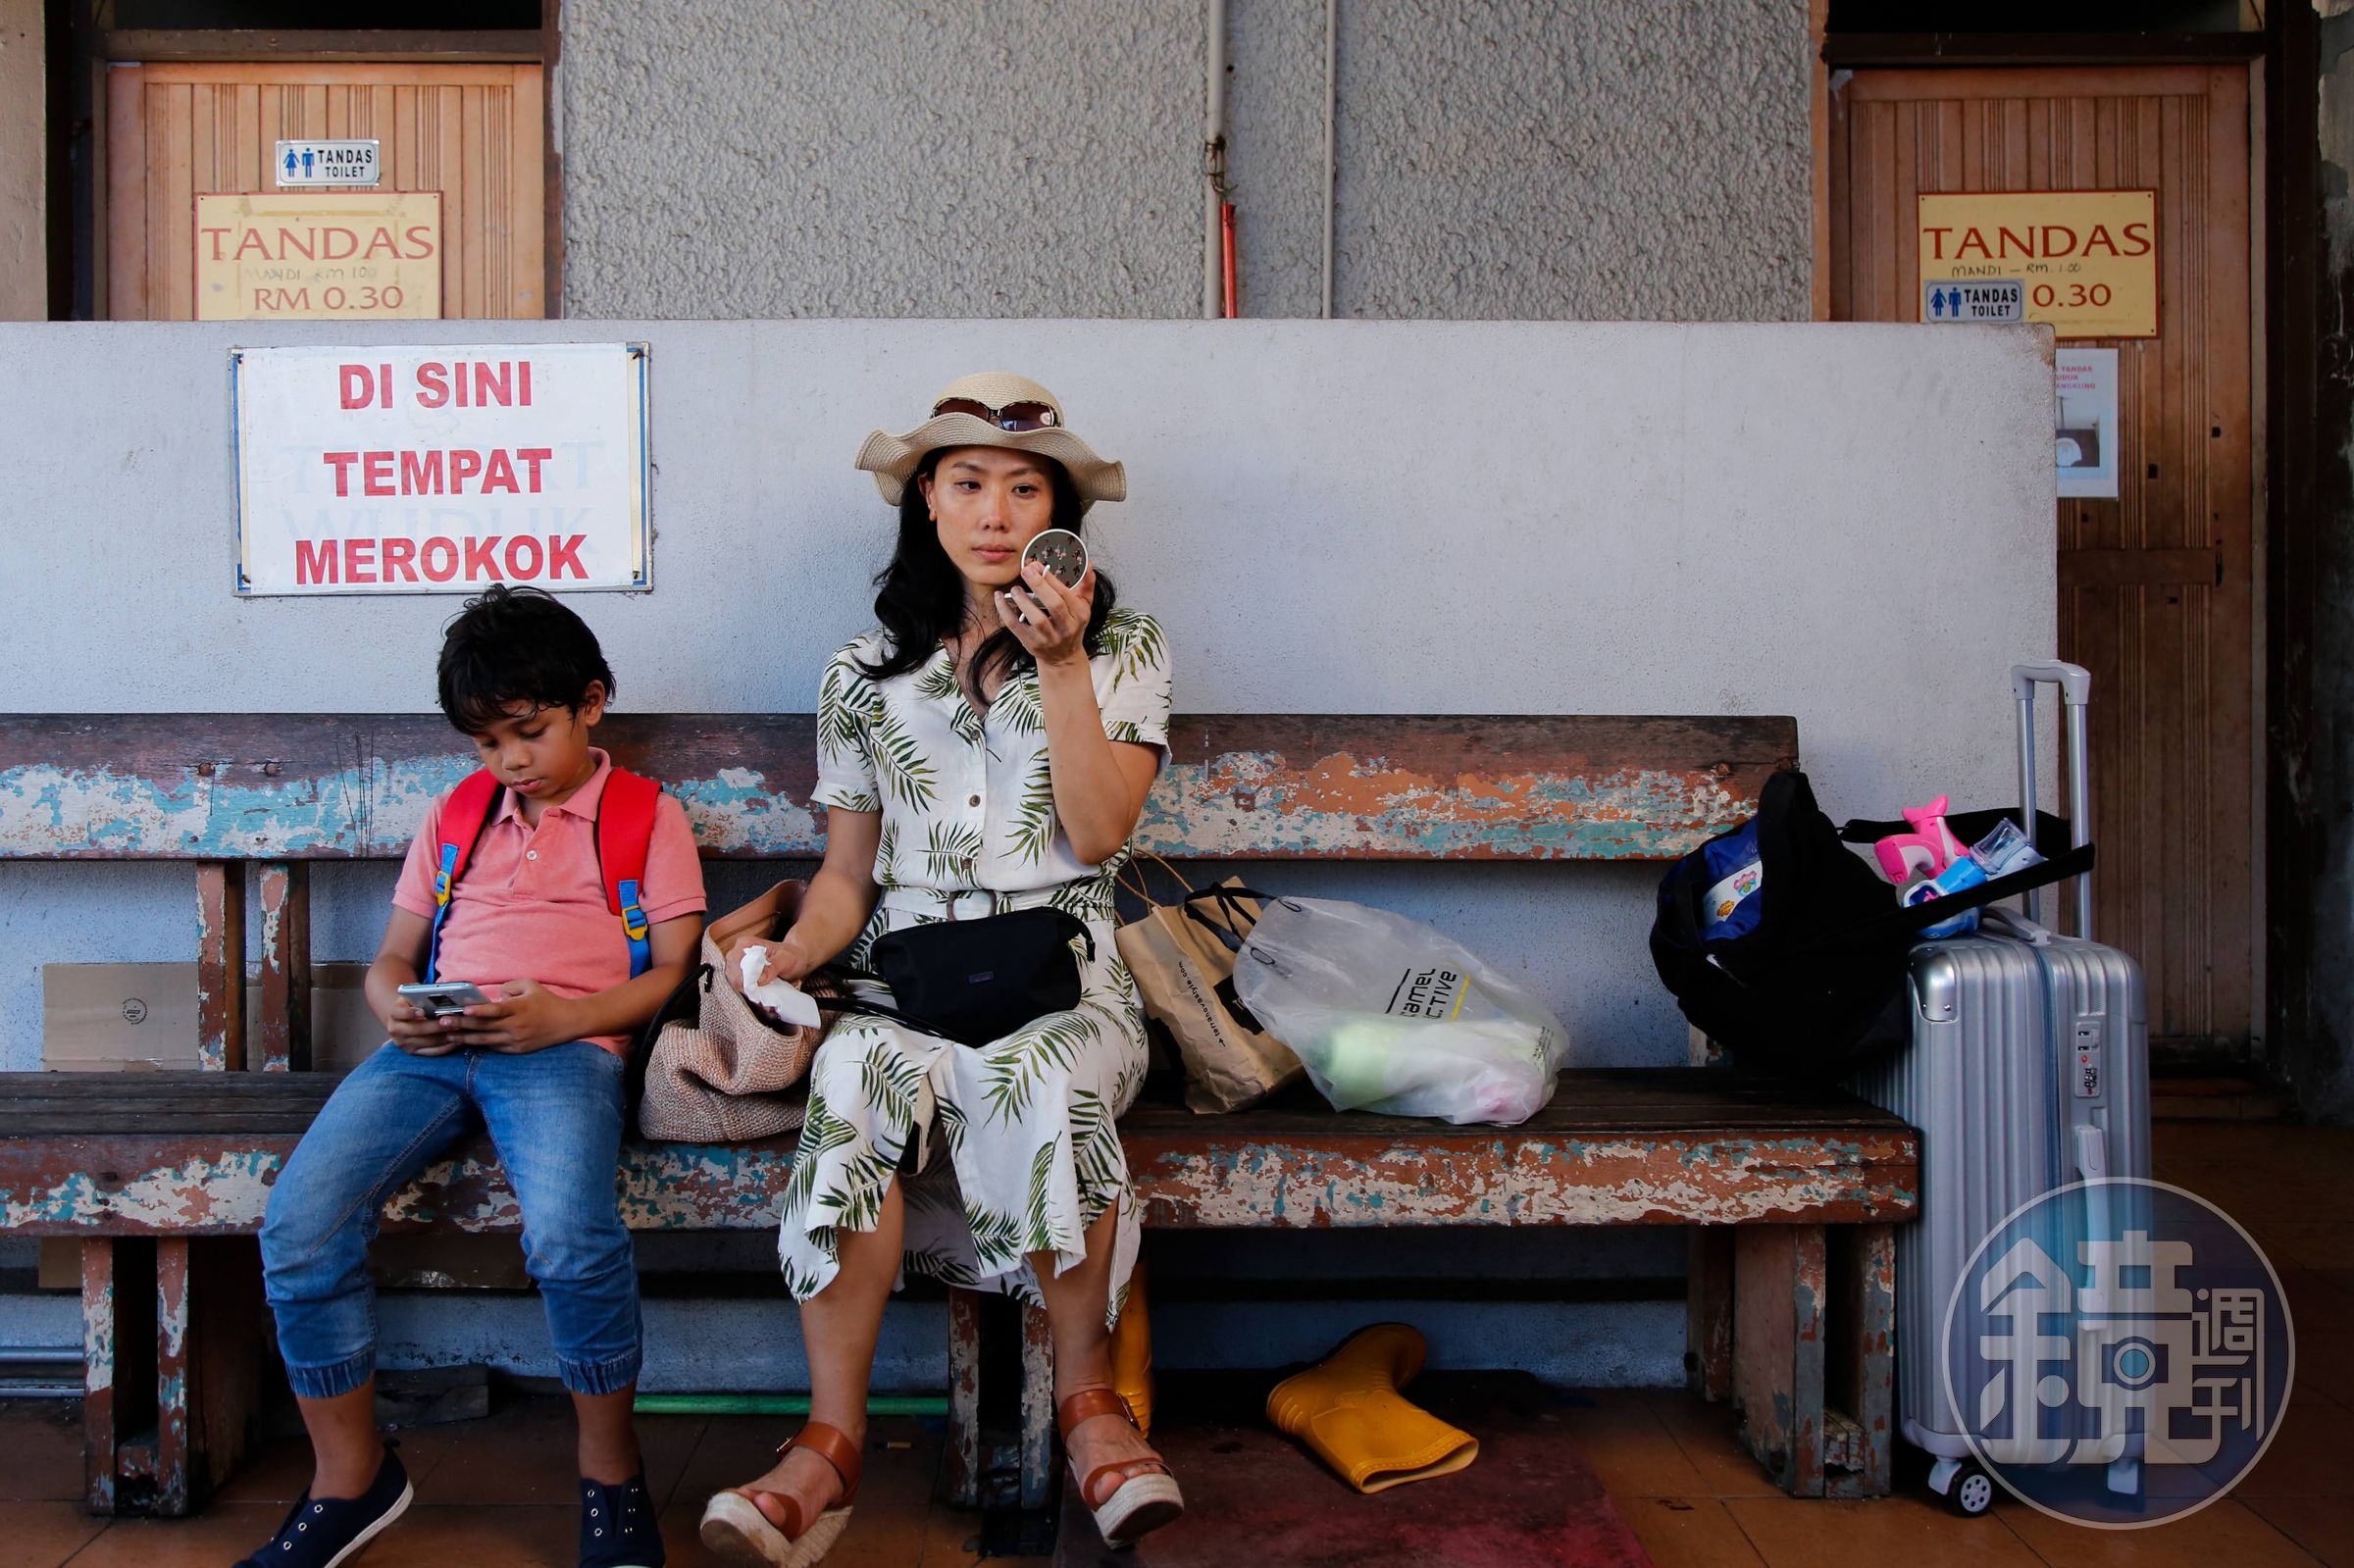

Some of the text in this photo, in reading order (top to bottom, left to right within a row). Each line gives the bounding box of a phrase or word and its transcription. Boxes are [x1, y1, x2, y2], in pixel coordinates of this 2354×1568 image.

[318, 149, 373, 164] TANDAS
[326, 166, 366, 177] TOILET
[201, 226, 435, 262] TANDAS
[1922, 223, 2151, 260] TANDAS
[253, 285, 404, 311] RM 0.30
[1965, 287, 2019, 304] TANDAS
[2032, 283, 2112, 308] 0.30
[1971, 304, 2011, 317] TOILET
[339, 361, 532, 410] DI SINI
[323, 447, 552, 497] TEMPAT
[295, 534, 589, 585] MEROKOK
